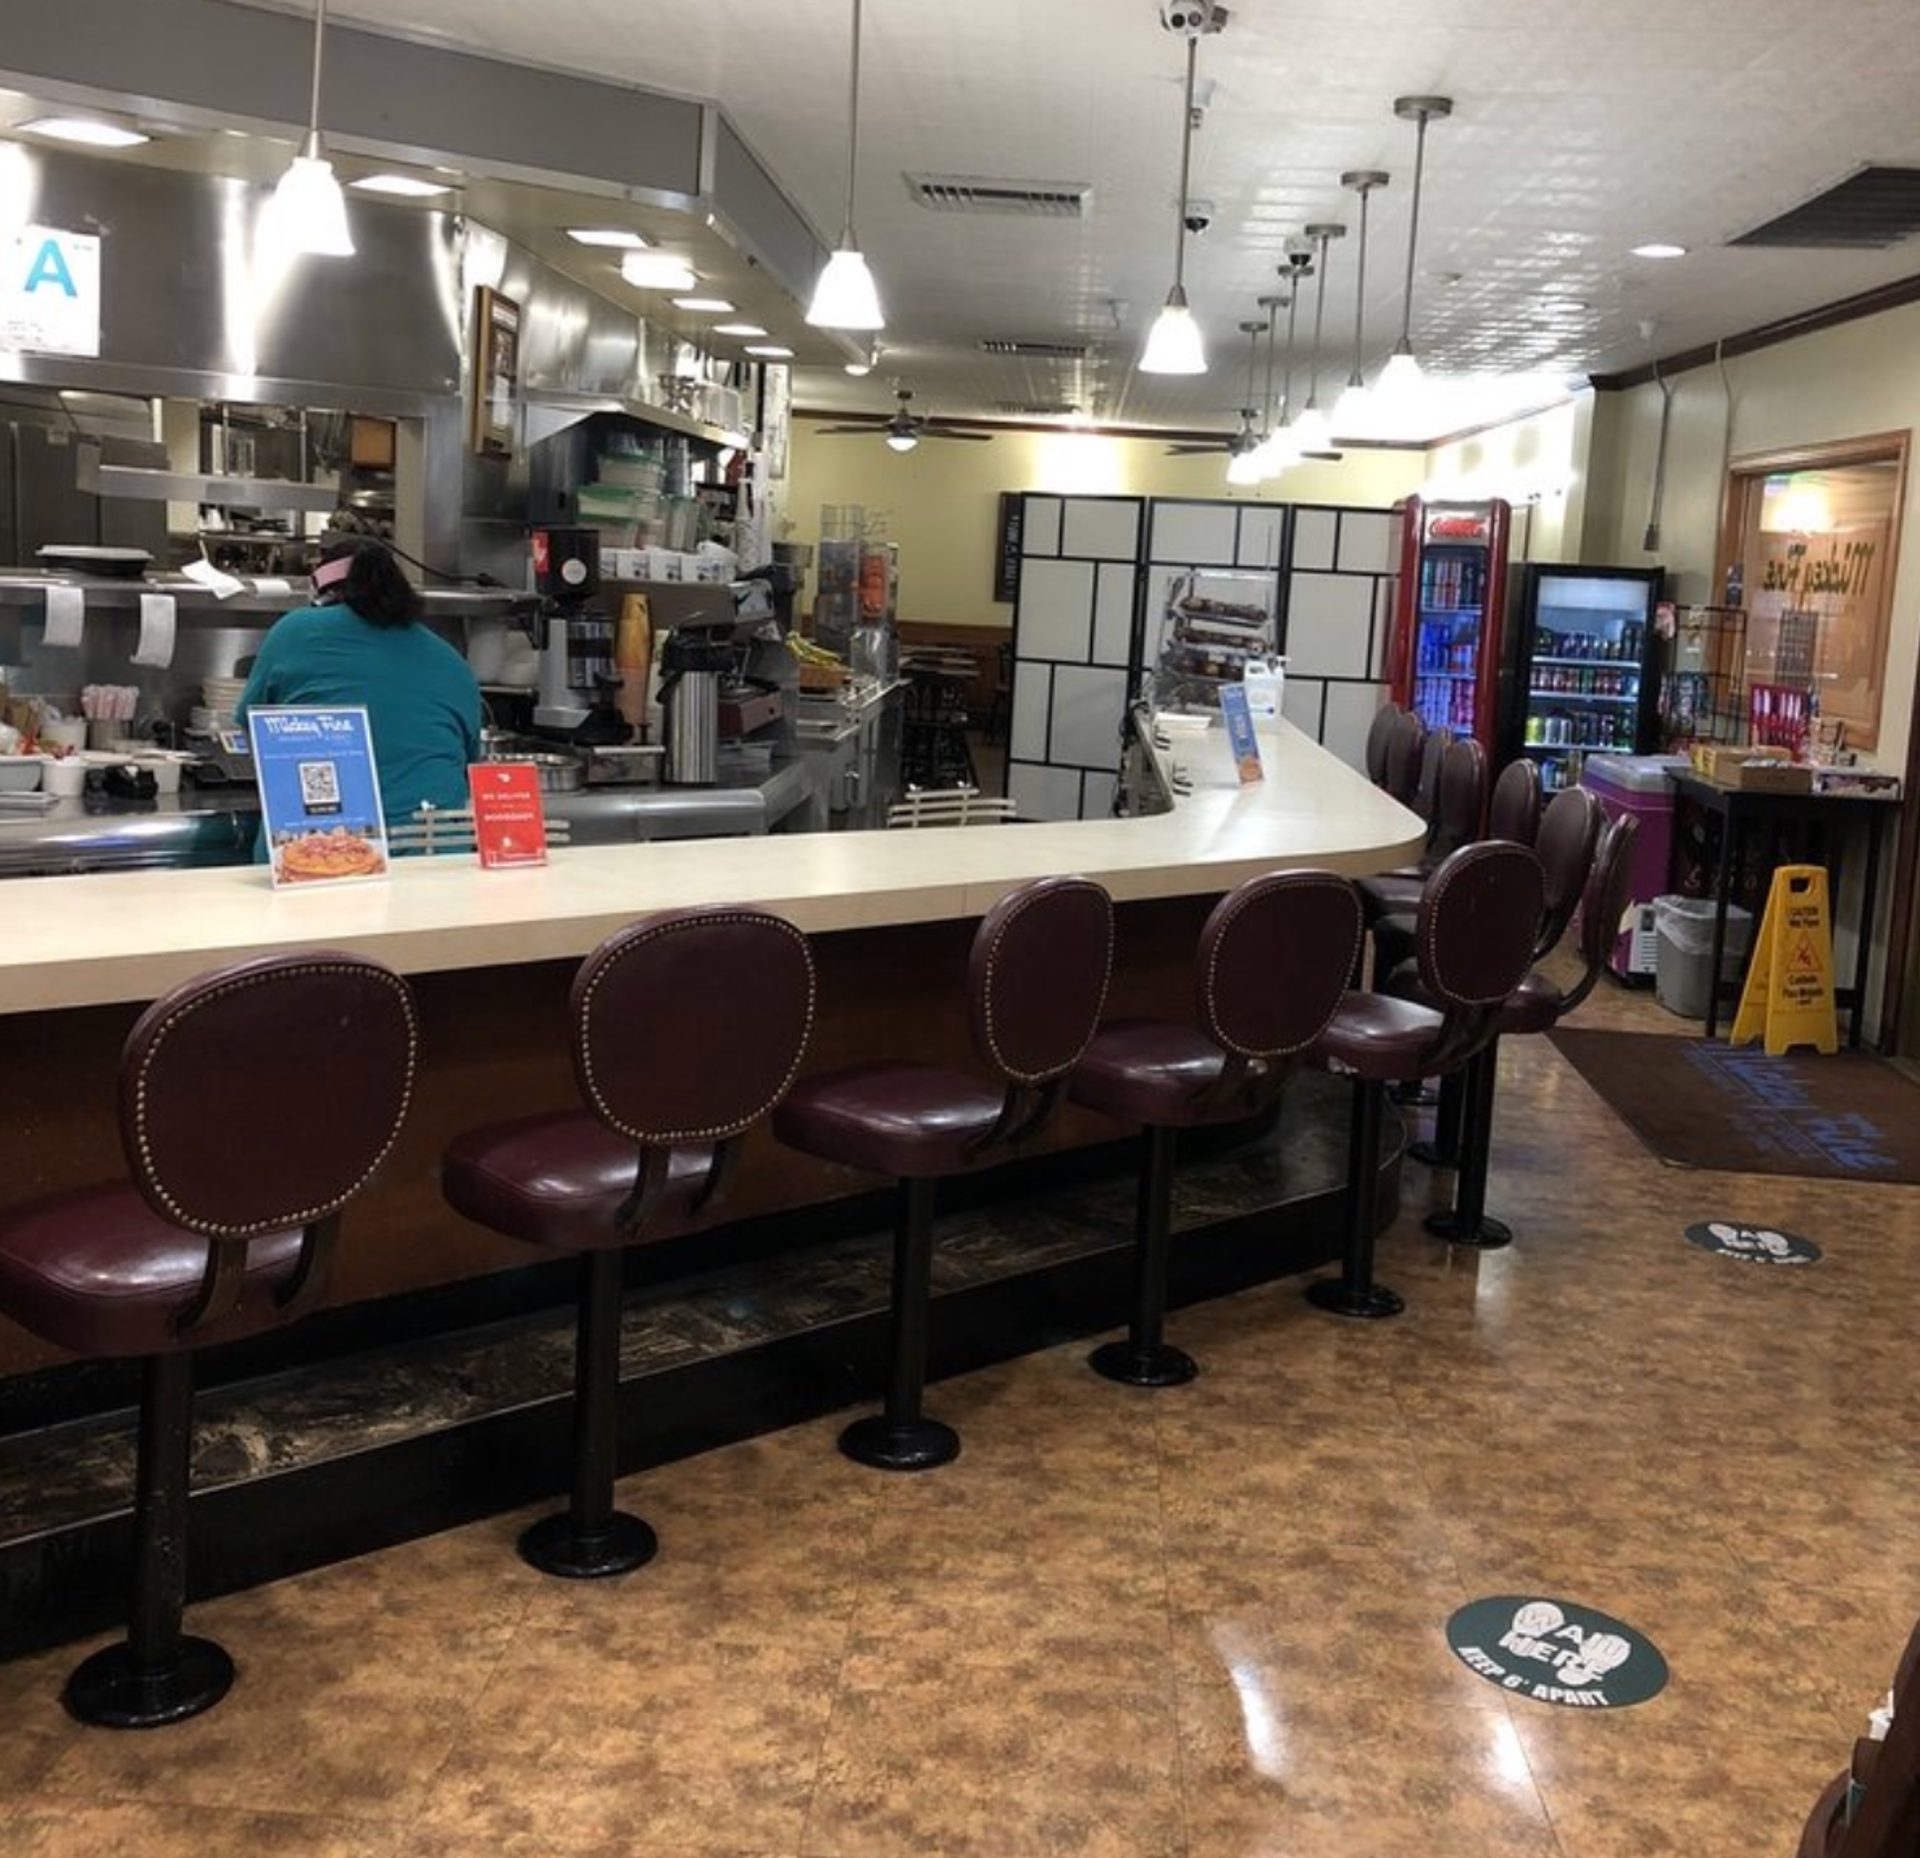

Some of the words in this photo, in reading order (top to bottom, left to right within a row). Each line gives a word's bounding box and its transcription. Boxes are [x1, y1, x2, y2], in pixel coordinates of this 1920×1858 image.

[24, 239, 78, 298] A
[1457, 1645, 1506, 1677] KEEP
[1532, 1682, 1610, 1706] APART
